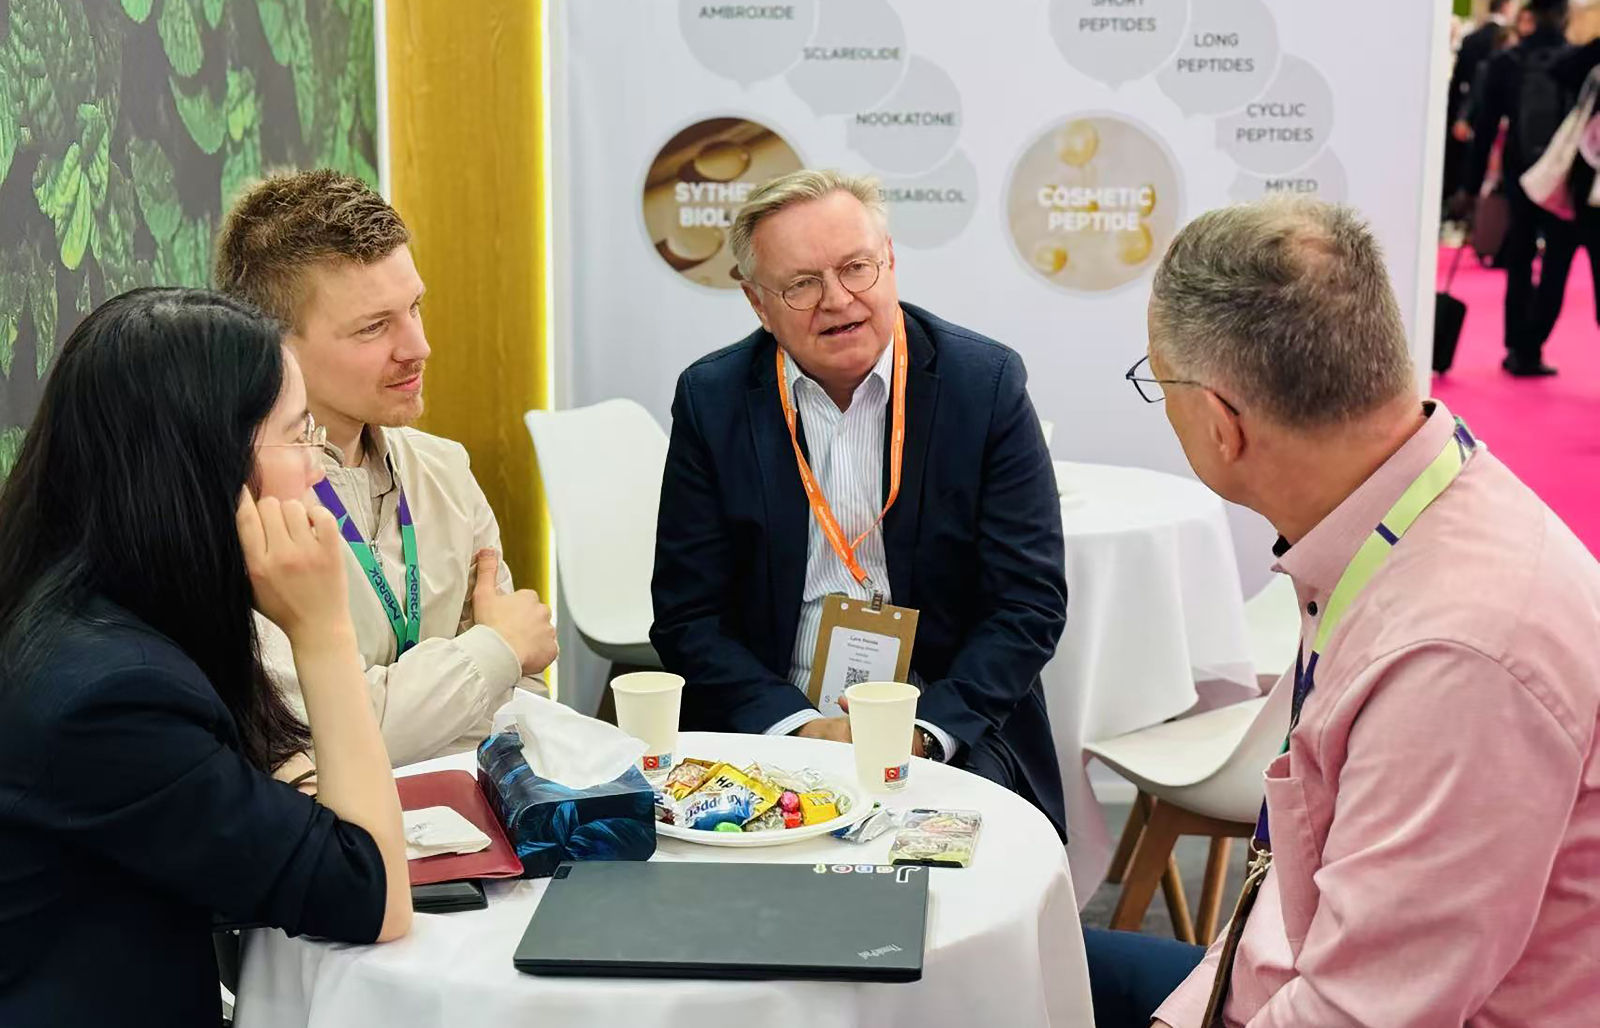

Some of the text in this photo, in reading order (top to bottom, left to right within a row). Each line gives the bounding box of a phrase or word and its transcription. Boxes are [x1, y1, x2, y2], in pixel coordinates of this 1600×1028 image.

[699, 6, 795, 20] AMBROXIDE
[1079, 17, 1156, 32] PEPTIDES
[1194, 33, 1239, 47] LONG
[803, 47, 900, 60] SCLAREOLIDE
[1177, 58, 1254, 72] PEPTIDES
[1246, 103, 1306, 118] CYCLIC
[856, 112, 954, 126] NOOKATONE
[1236, 128, 1313, 142] PEPTIDES
[675, 182, 756, 203] SYTHE
[1038, 186, 1153, 207] COSMETIC
[1048, 211, 1139, 231] PEPTIDE
